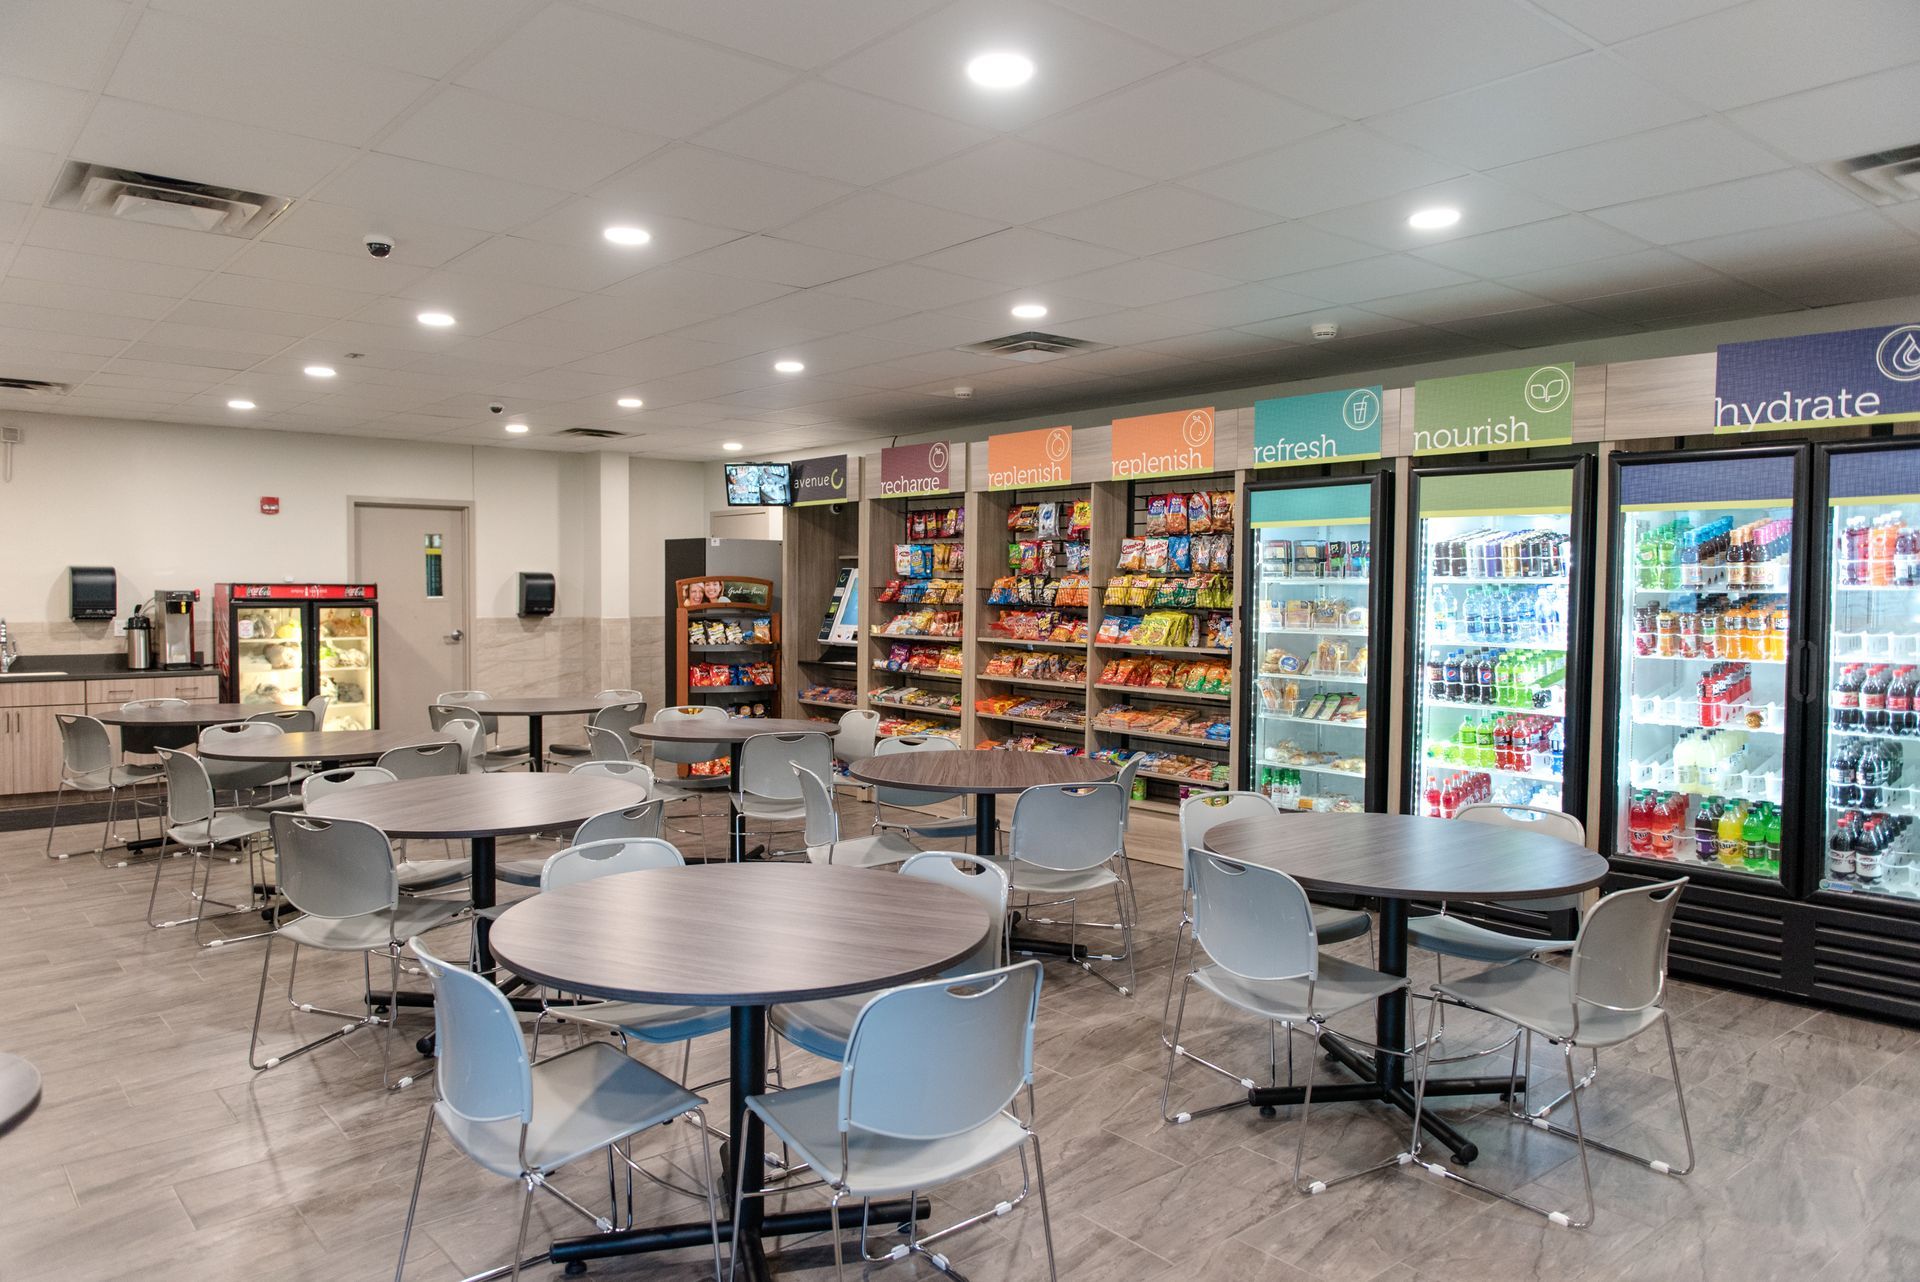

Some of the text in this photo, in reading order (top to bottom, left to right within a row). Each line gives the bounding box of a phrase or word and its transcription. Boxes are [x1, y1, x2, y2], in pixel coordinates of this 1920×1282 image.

[1714, 388, 1880, 433] hydrate
[1253, 434, 1339, 463] refresh
[1413, 416, 1530, 450] nourish
[988, 461, 1063, 489] replenish
[1111, 447, 1204, 480] replenish
[881, 475, 940, 496] recharge
